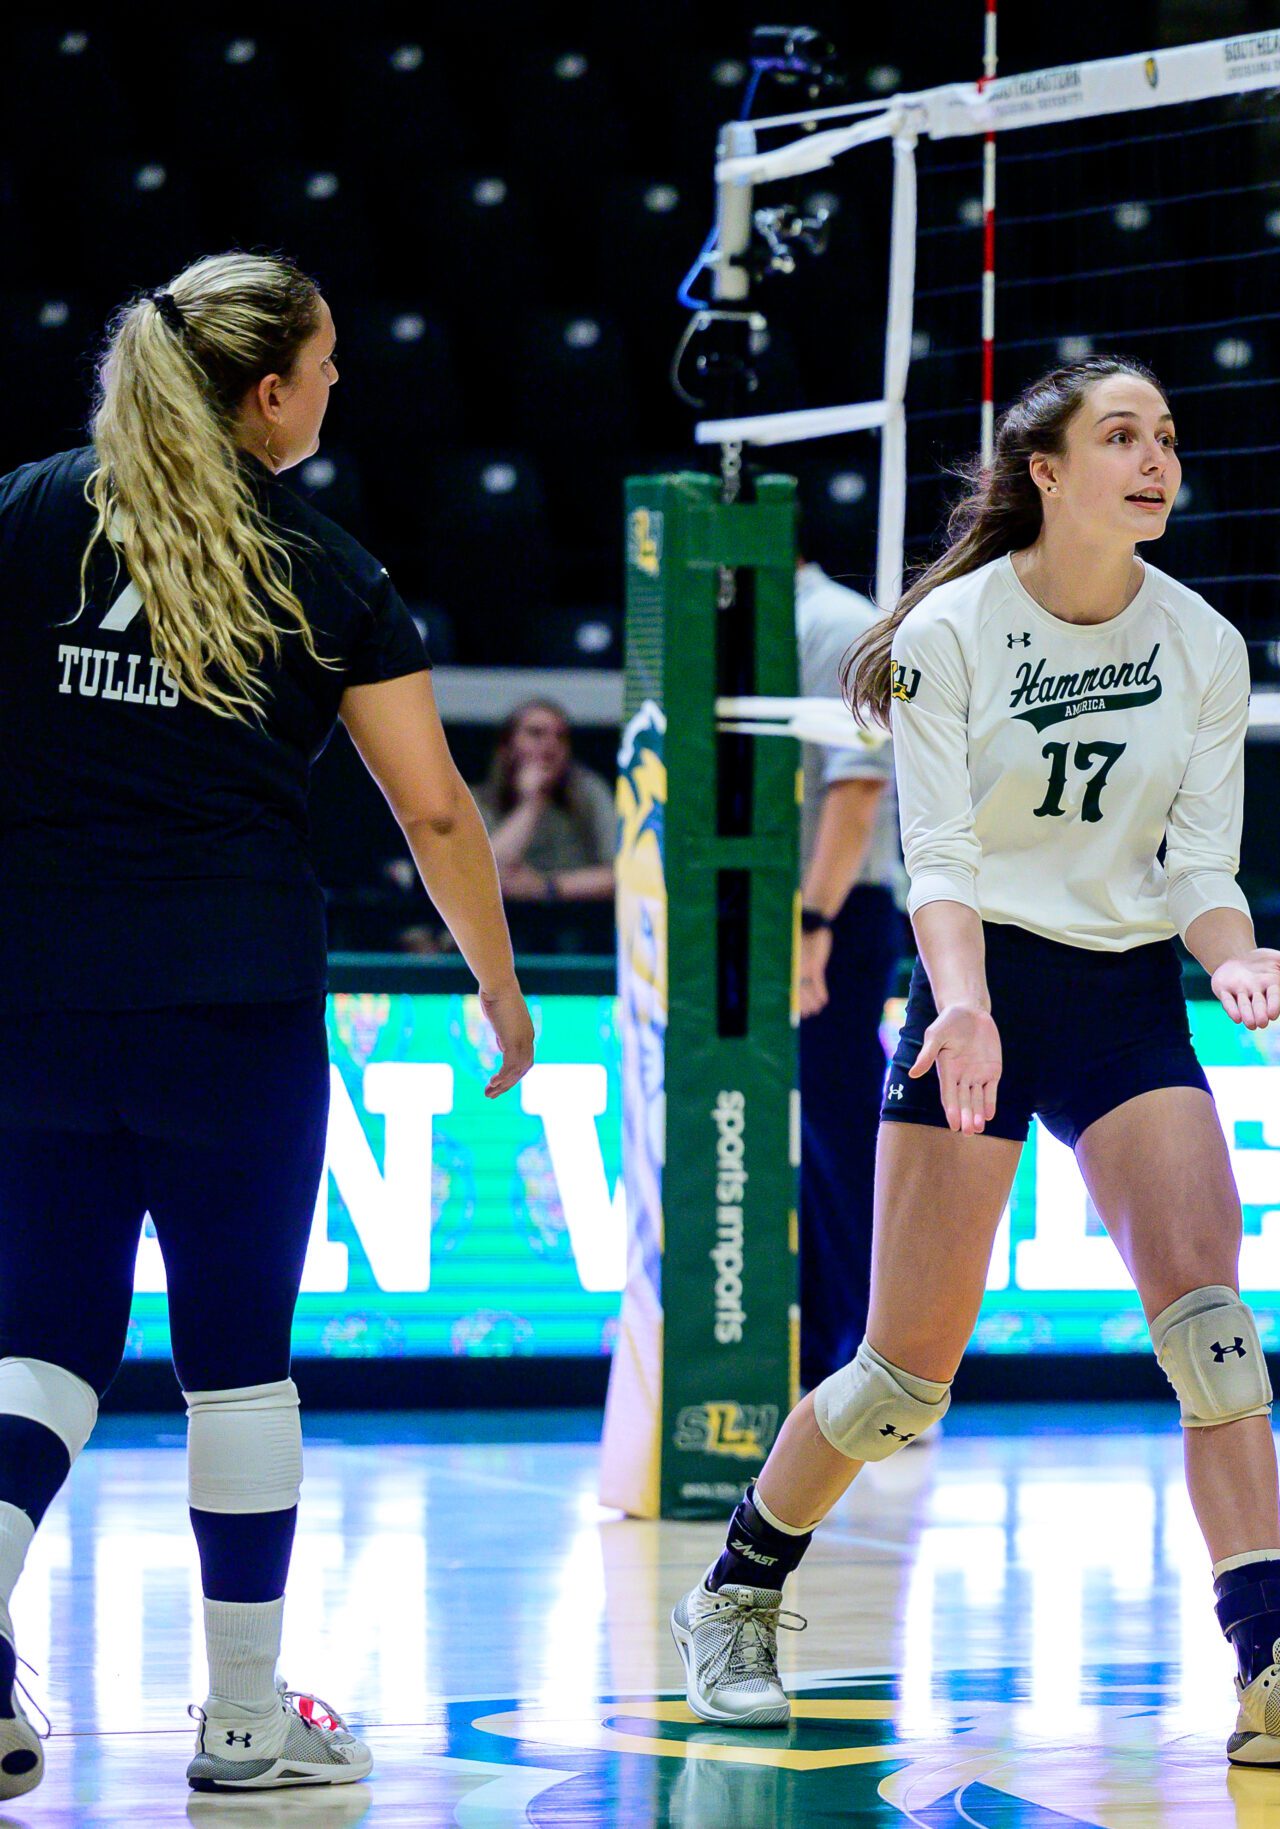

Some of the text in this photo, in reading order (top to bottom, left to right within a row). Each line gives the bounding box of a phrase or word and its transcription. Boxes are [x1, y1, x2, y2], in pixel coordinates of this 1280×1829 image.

[58, 644, 181, 708] TULLIS
[1009, 643, 1160, 708] Hammond
[1064, 698, 1106, 718] AMRICA
[1033, 741, 1127, 823] 17
[710, 1089, 749, 1203] sports
[731, 1539, 779, 1567] ZAMST
